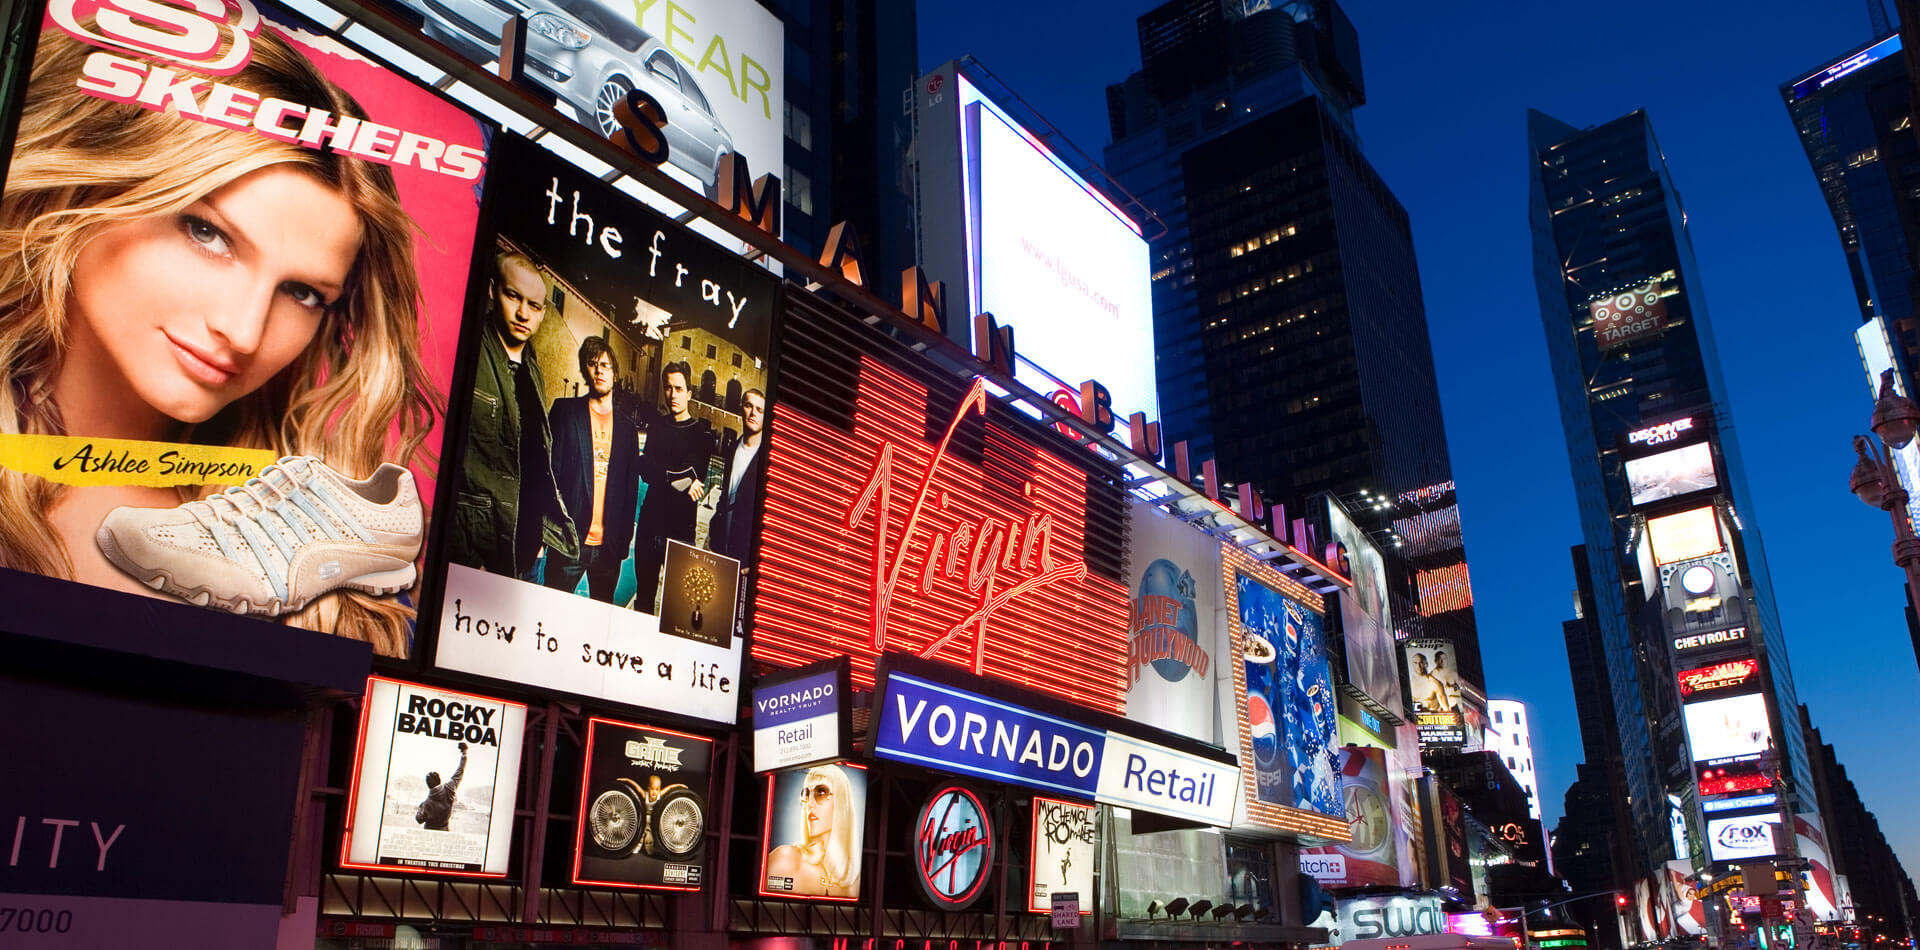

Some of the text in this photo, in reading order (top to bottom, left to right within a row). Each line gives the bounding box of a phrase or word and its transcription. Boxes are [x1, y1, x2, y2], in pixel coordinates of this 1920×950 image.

[928, 93, 943, 107] LG
[77, 52, 487, 180] SKECHERS
[546, 176, 748, 329] the fray
[1021, 236, 1120, 320] www.lgusa.com
[1602, 316, 1661, 342] TARGET
[1628, 417, 1693, 444] DISCOVER
[1647, 431, 1678, 446] CARD
[53, 443, 255, 479] Ashlee Simpson
[850, 376, 1088, 676] Virgin
[454, 598, 731, 693] how to save a life
[1674, 627, 1746, 650] CHEVROLET
[1127, 627, 1209, 692] HOLLYWOOD
[758, 684, 834, 713] VORNADO
[1694, 677, 1745, 691] SELECT
[408, 694, 496, 727] ROCKY
[770, 700, 822, 716] REALTY TRUST
[1417, 715, 1456, 725] COUTURE
[397, 712, 498, 748] BALBOA
[778, 722, 813, 745] Retail
[897, 693, 1095, 779] VORNADO
[625, 740, 684, 766] GAME
[1124, 752, 1216, 808] Retail
[1258, 768, 1282, 795] EPSI
[9, 816, 126, 872] ITY
[920, 792, 988, 894] Virgin
[1728, 824, 1767, 839] FOX
[0, 908, 72, 934] 7000
[1352, 899, 1443, 940] swat
